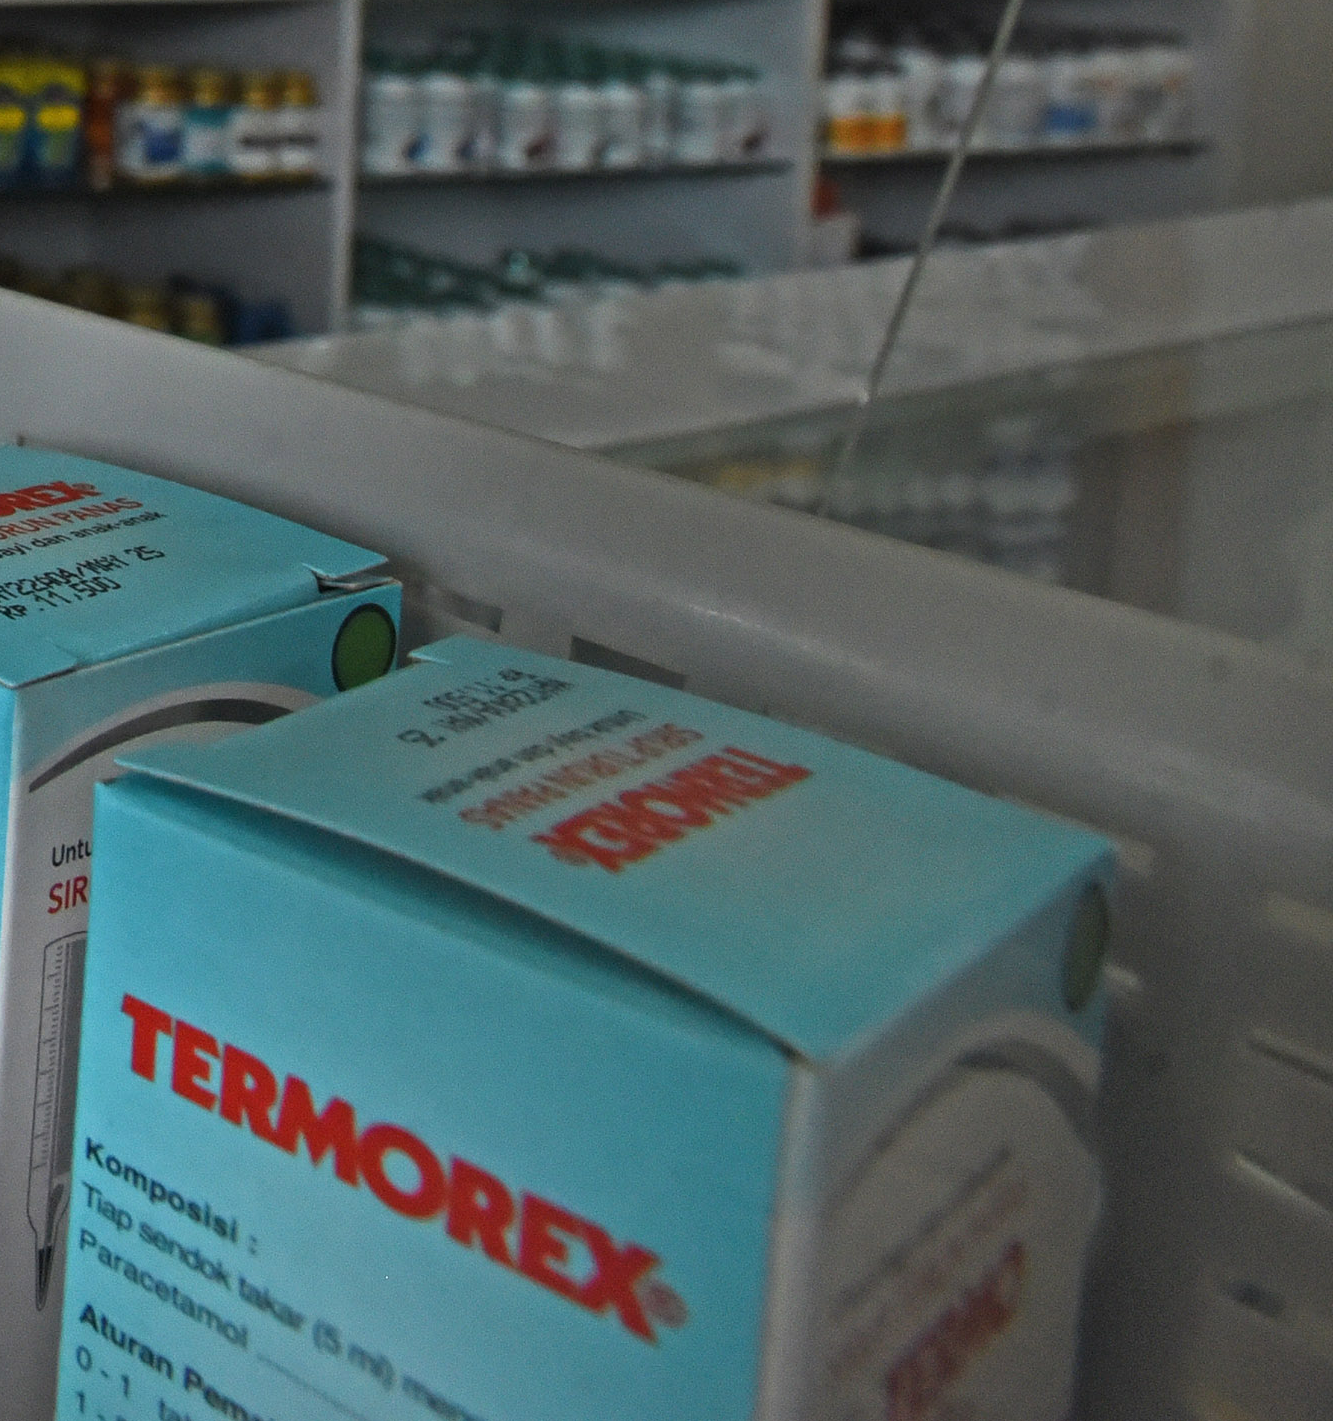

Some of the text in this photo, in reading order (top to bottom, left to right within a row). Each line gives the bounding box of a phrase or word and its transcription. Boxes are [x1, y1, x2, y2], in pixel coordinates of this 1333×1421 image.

[51, 496, 144, 523] PANAS
[84, 1135, 239, 1244] Komposisi
[77, 1228, 250, 1350] Paracetamol
[78, 1302, 174, 1379] Aturan
